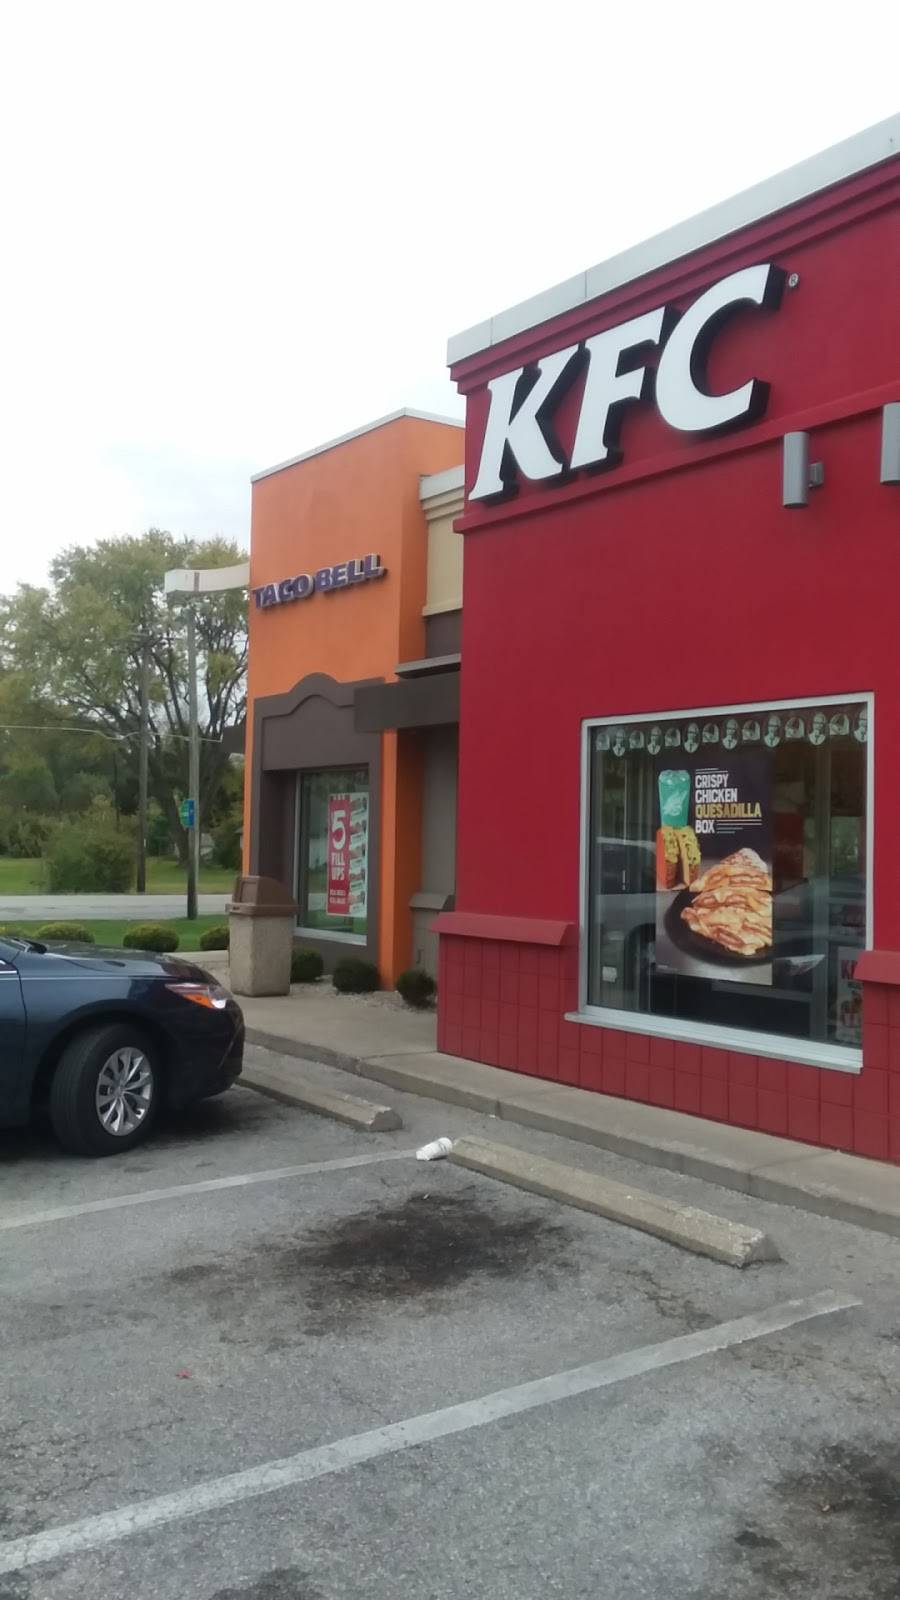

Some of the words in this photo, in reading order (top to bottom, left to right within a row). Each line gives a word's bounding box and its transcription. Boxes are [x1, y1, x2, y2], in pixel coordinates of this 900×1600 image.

[468, 263, 772, 501] KFC
[251, 574, 314, 609] TACO
[314, 553, 386, 592] BELL
[695, 773, 729, 789] CRISPY
[695, 788, 738, 804] CHICKEN
[695, 803, 762, 819] QUESADILLA
[695, 819, 716, 834] BOX
[331, 852, 346, 866] FILL
[331, 866, 345, 880] UPS
